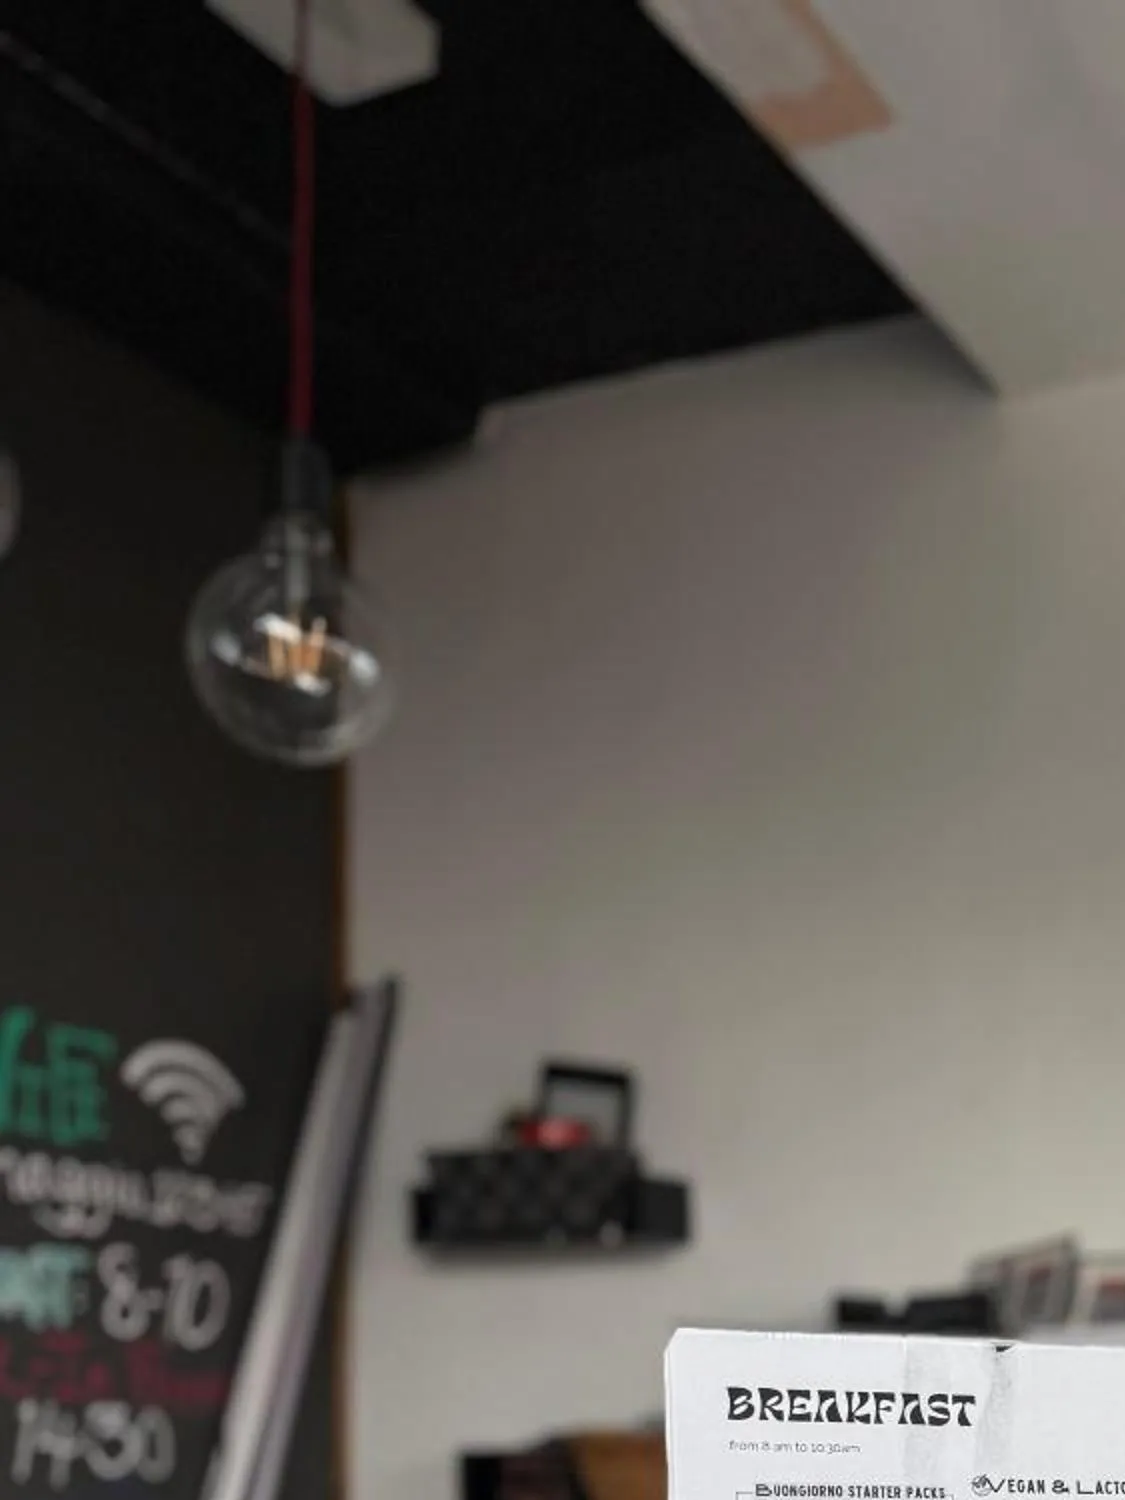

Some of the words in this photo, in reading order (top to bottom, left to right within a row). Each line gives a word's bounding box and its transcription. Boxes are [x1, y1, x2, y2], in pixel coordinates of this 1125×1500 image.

[727, 1387, 976, 1426] BREAKFAST
[729, 1440, 759, 1452] from
[773, 1444, 792, 1452] am
[795, 1442, 807, 1453] to
[755, 1483, 843, 1497] BUONGIORNO
[848, 1485, 900, 1498] STARTER
[906, 1486, 946, 1499] PACKS
[983, 1476, 1046, 1494] VEGAN
[1052, 1480, 1069, 1494] &
